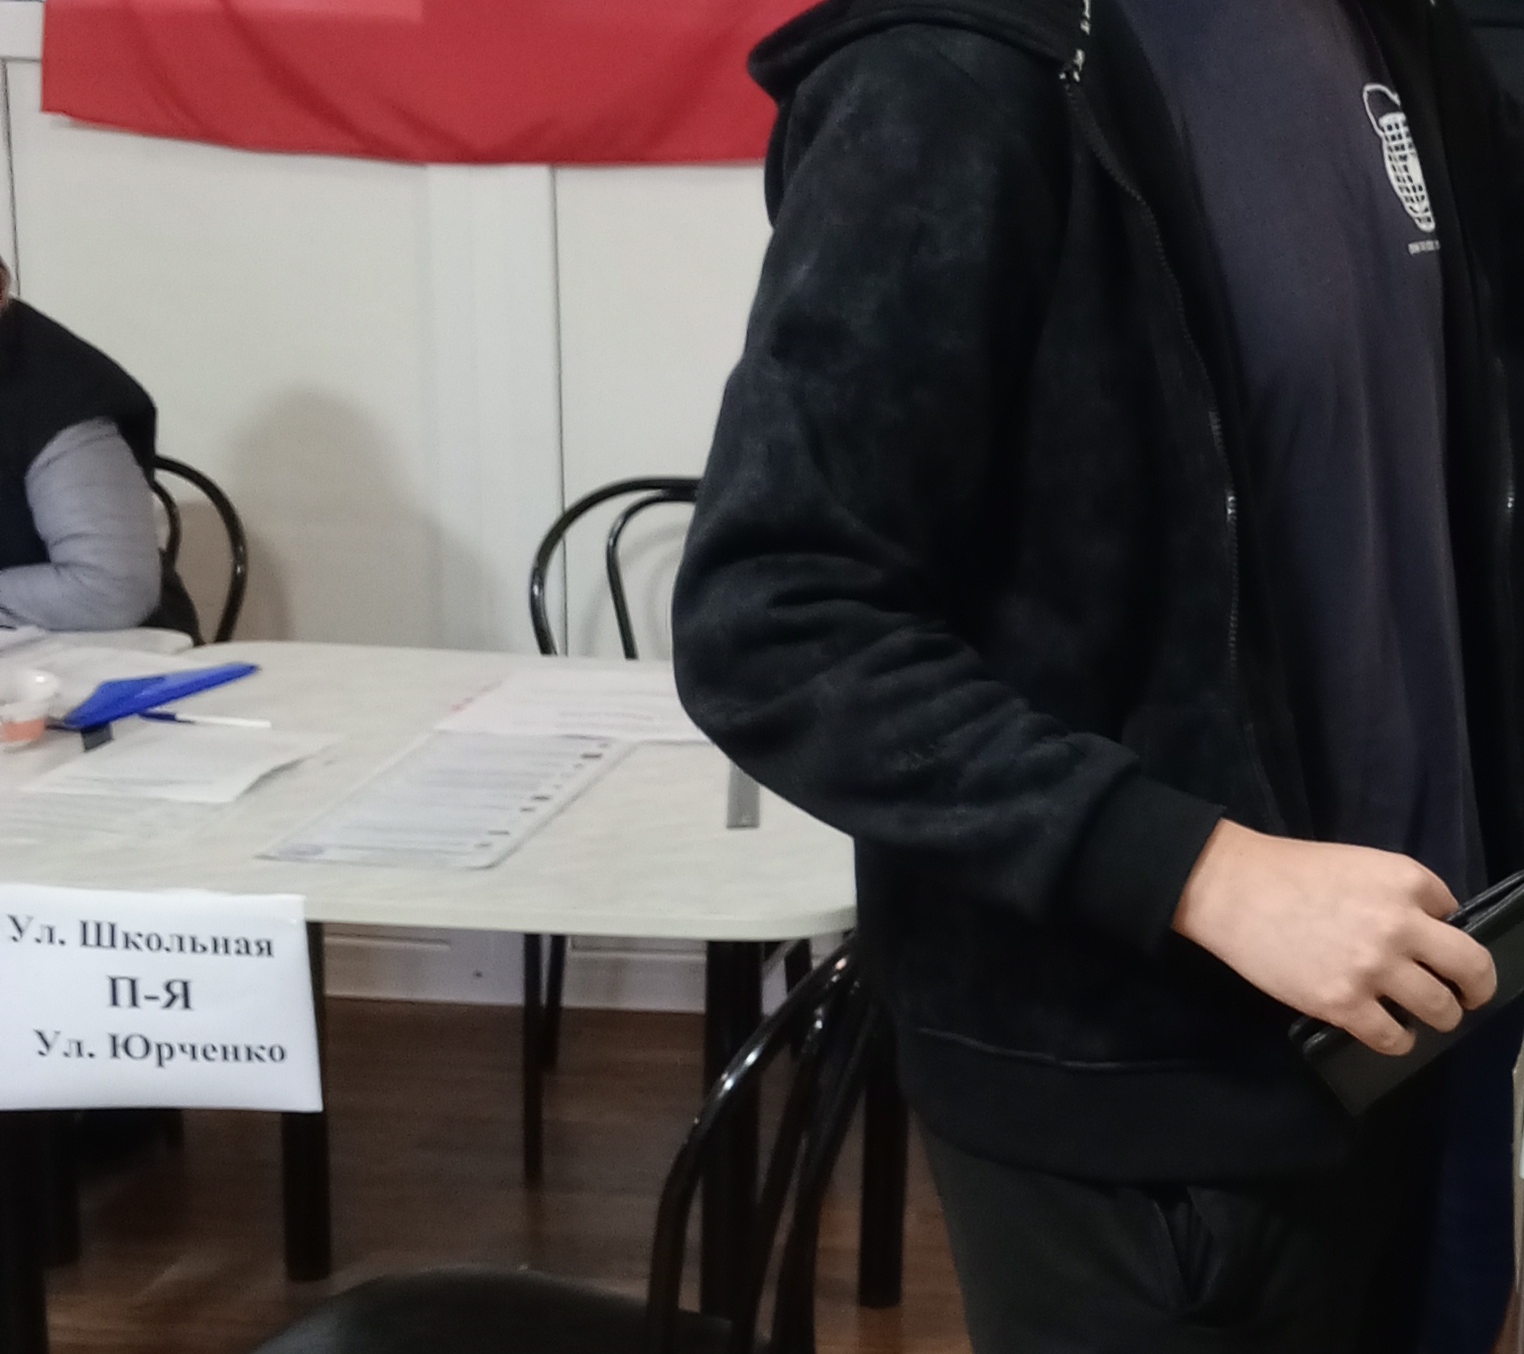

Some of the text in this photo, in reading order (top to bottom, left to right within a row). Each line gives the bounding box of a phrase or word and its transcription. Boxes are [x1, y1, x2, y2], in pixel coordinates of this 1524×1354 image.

[7, 913, 276, 959] Ул. Школьная
[106, 974, 195, 1011] П-Я
[33, 1028, 287, 1070] Ул. Юрченко
